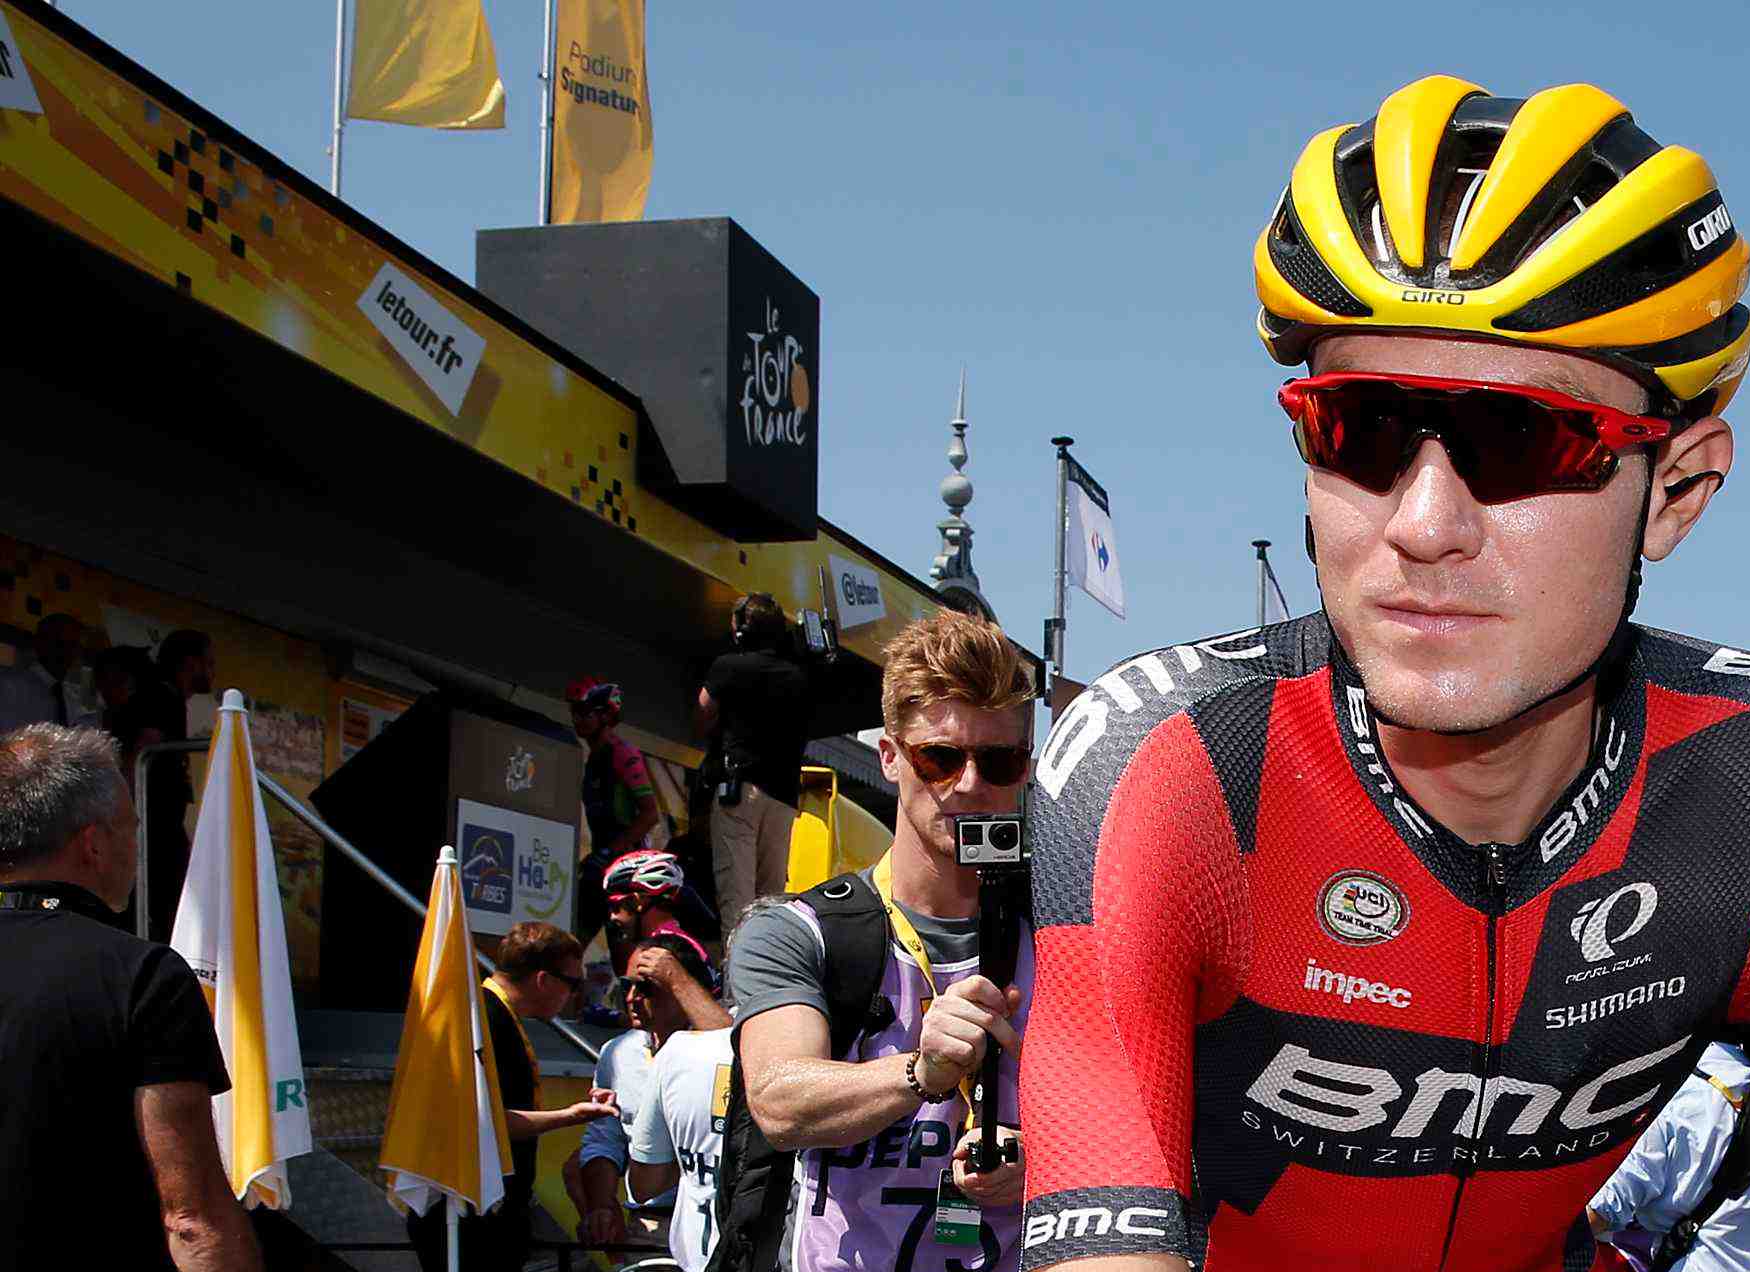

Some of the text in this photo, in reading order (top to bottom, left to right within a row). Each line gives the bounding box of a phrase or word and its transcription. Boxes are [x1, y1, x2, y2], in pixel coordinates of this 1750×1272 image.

[561, 66, 640, 115] Signatur
[1401, 290, 1465, 306] GIRO
[376, 280, 463, 375] letour.fr
[1035, 627, 1267, 800] BMC
[1540, 720, 1626, 864] BMC
[1304, 958, 1412, 1008] impec
[1545, 976, 1686, 1029] SHIMANO
[1245, 1034, 1693, 1139] BMC
[1241, 1110, 1611, 1164] SWITZERLAND
[1025, 1205, 1167, 1247] BMC
